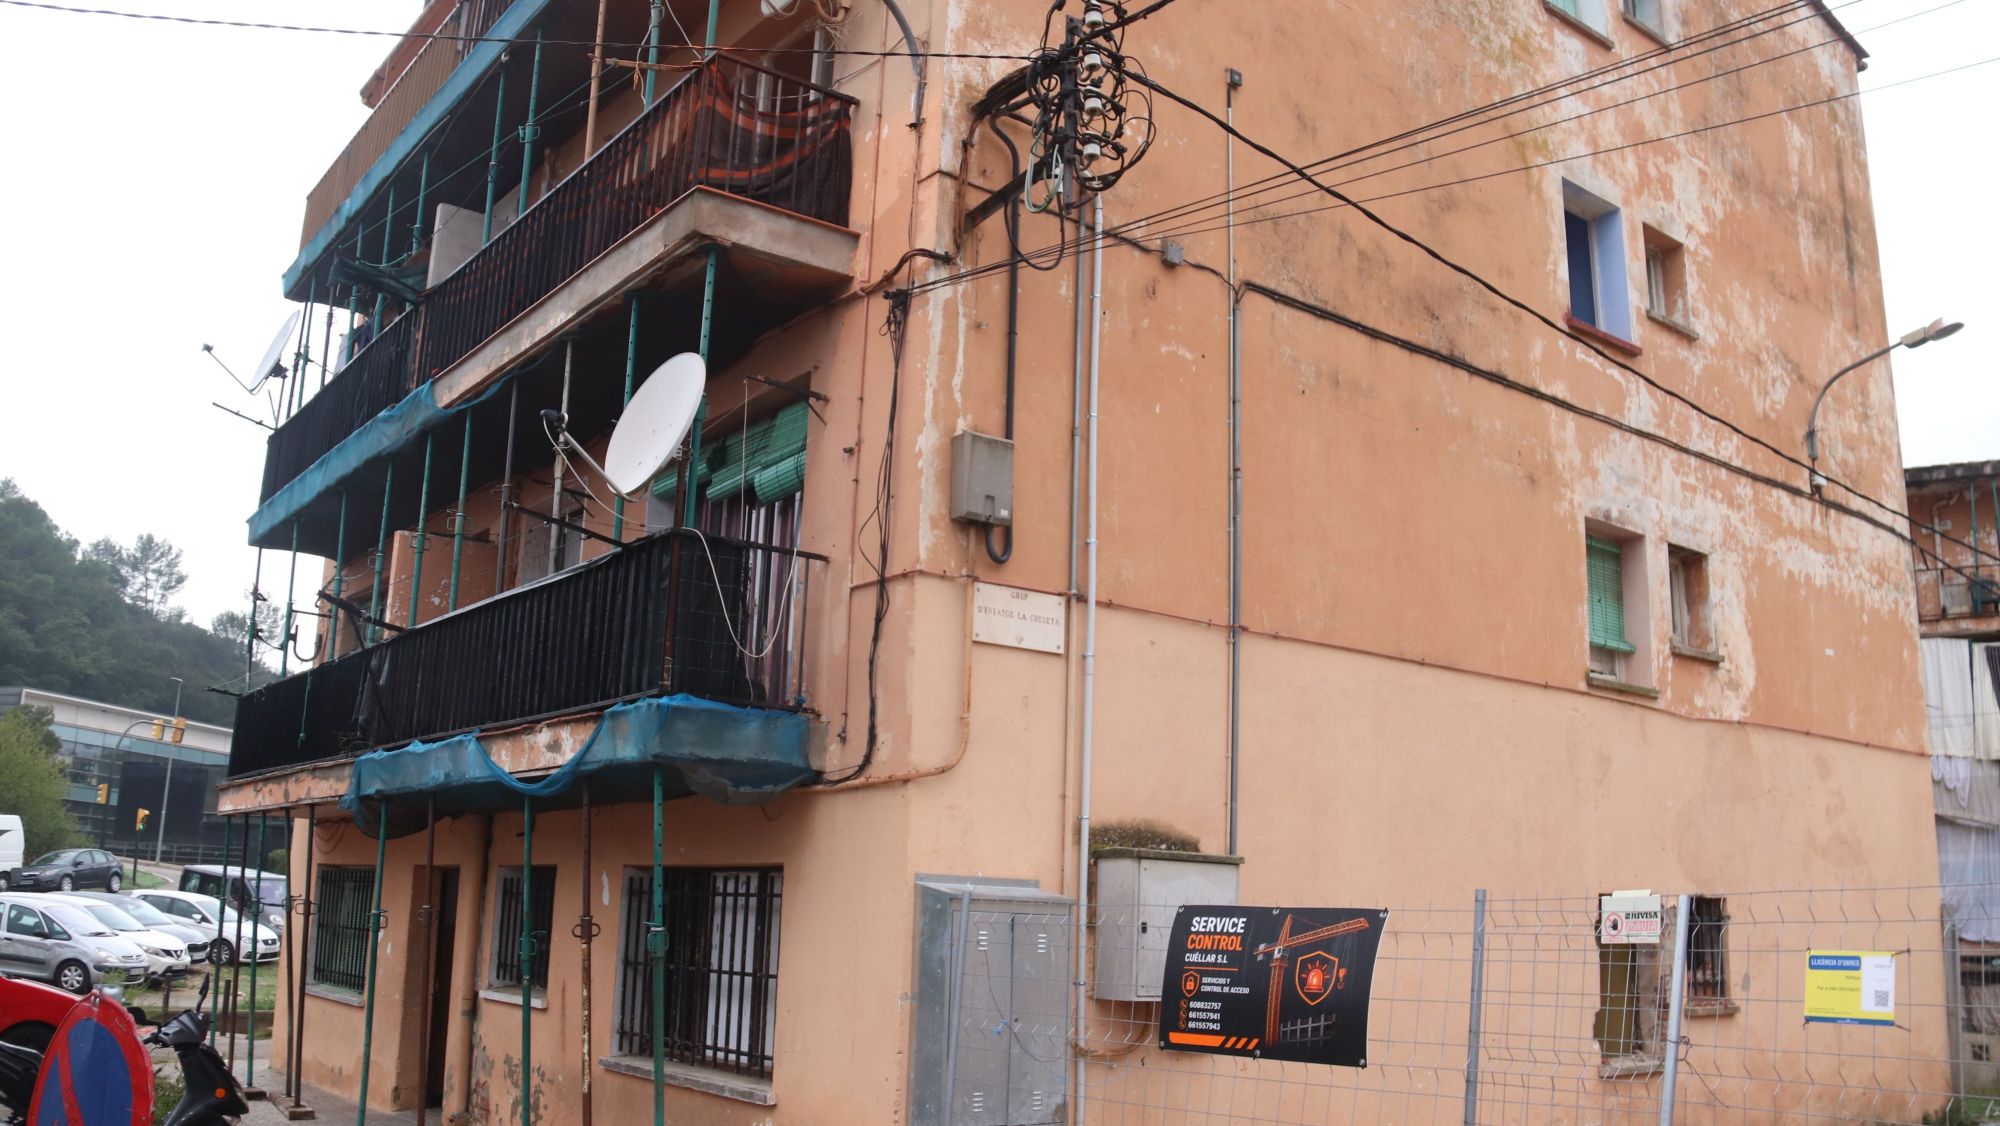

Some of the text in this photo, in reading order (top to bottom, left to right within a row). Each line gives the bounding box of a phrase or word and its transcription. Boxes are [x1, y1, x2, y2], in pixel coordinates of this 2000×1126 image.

[1011, 592, 1029, 601] GRUP
[1017, 611, 1027, 621] LA
[1190, 916, 1247, 933] SERVICE
[1187, 934, 1242, 951] CONTROL
[1185, 952, 1228, 963] CUÉLLAR S.L
[1200, 985, 1223, 993] CONTROL
[1188, 1011, 1220, 1020] 661557941
[1188, 1021, 1220, 1030] 661557943
